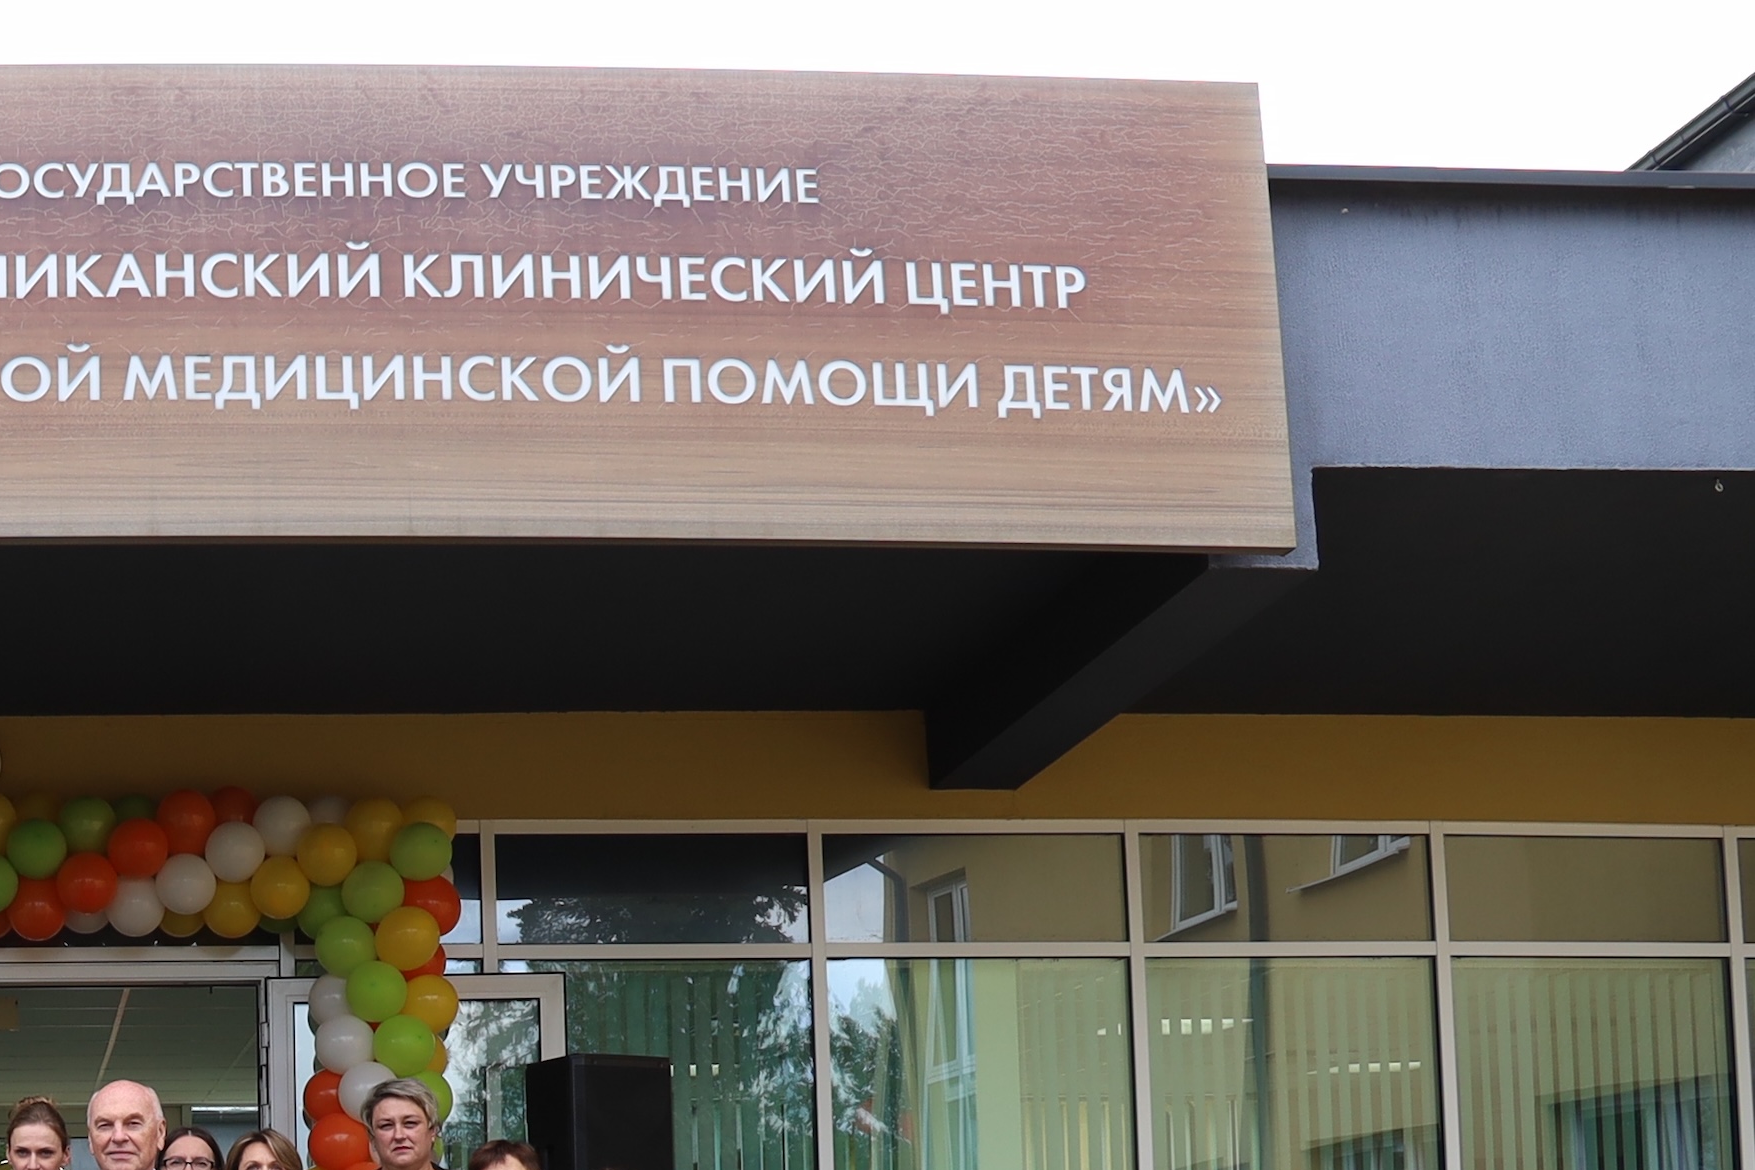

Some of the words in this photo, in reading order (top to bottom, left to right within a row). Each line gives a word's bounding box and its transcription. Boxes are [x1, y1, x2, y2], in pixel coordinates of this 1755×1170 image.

[479, 163, 821, 208] УЧРЕЖДЕНИЕ
[403, 247, 886, 305] КЛИНИЧЕСКИЙ
[905, 261, 1086, 314] ЦЕНТР
[123, 343, 642, 410] МЕДИЦИНСКОЙ
[663, 357, 979, 416] ПОМОЩИ
[997, 364, 1222, 418] ДЕТЯМ»
